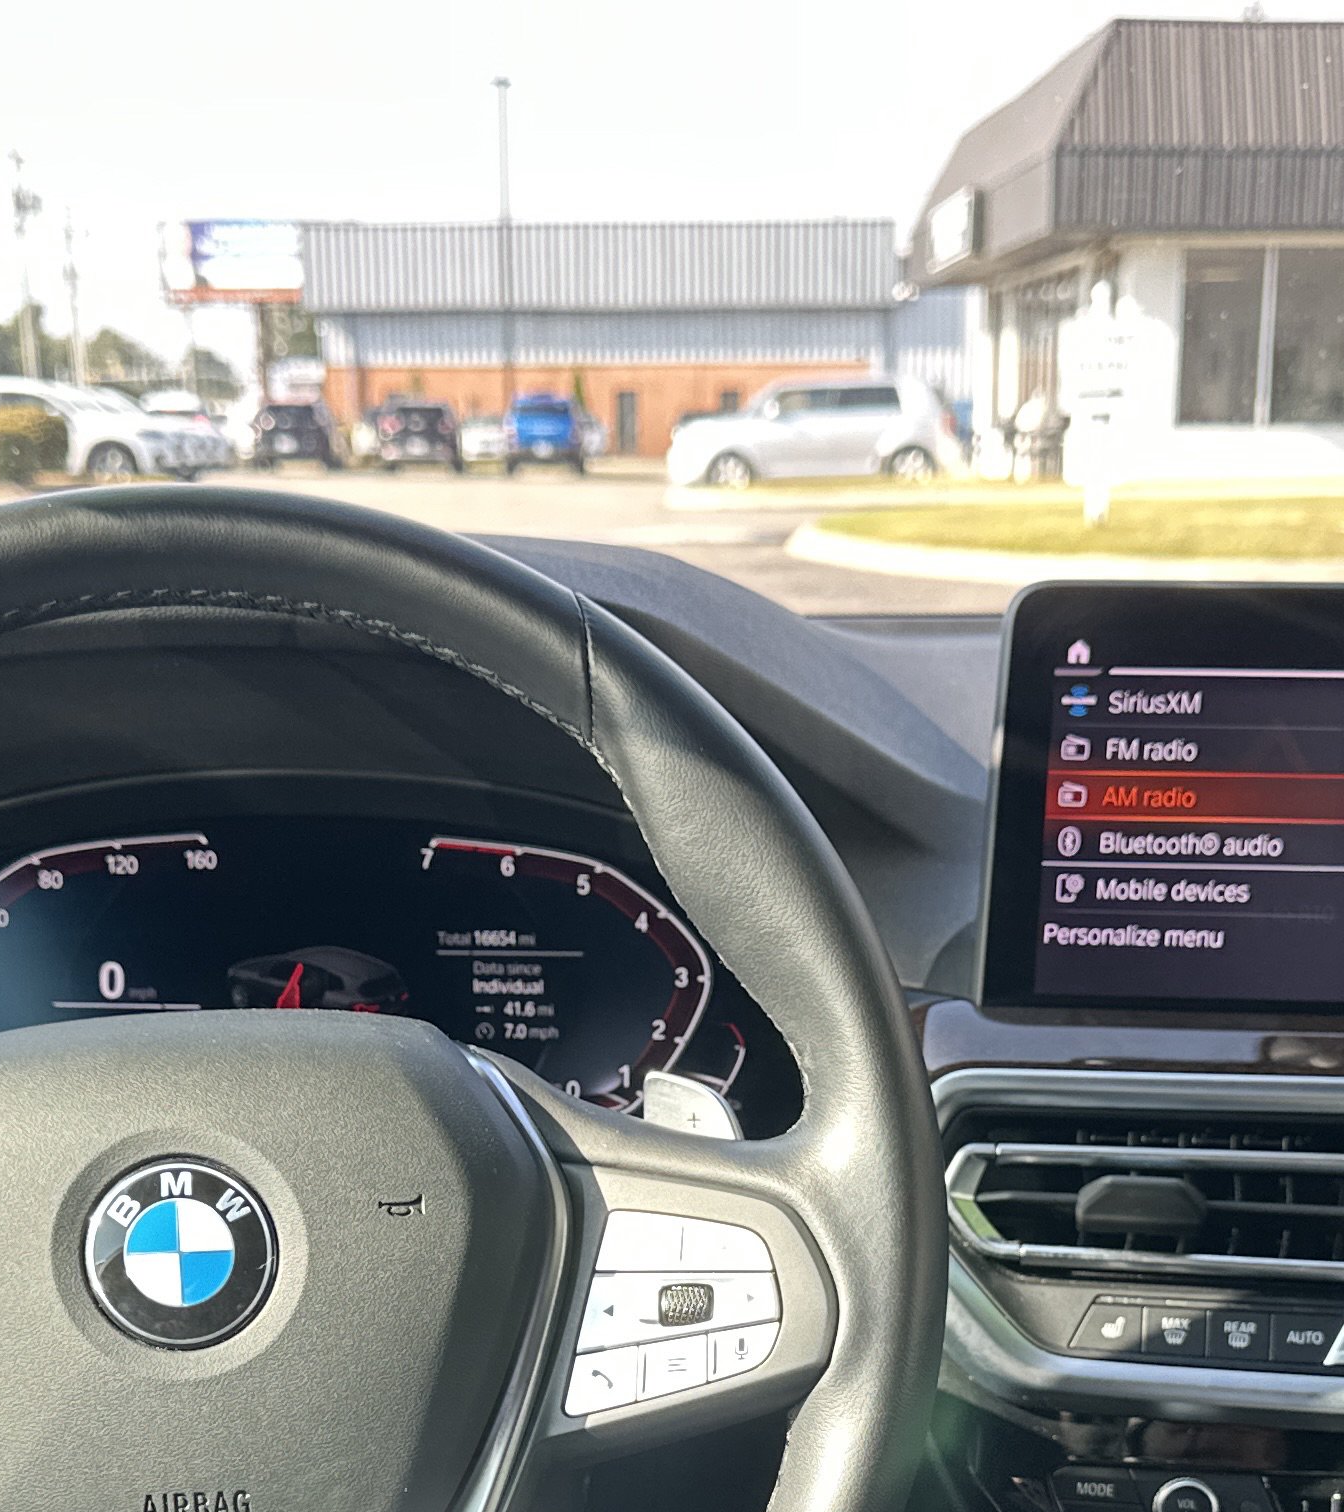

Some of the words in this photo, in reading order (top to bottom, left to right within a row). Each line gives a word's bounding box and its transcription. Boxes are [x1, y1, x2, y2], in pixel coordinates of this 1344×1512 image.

[1108, 690, 1203, 715] SiriusXM
[1105, 737, 1140, 761] FM
[1142, 738, 1199, 762] radio
[1102, 786, 1138, 808] AM
[1142, 786, 1197, 808] radio
[1222, 834, 1285, 857] audio
[106, 854, 140, 876] 120
[183, 849, 218, 870] 160
[420, 847, 435, 870] 7
[500, 855, 516, 877] 6
[37, 869, 65, 890] 80
[576, 874, 592, 896] 5
[1096, 878, 1168, 902] Mobile
[1170, 879, 1252, 904] devices
[634, 911, 650, 933] 4
[1042, 922, 1162, 948] Personalize
[1163, 929, 1225, 949] menu
[472, 960, 505, 977] Data
[506, 960, 543, 977] since
[674, 966, 690, 988] 3
[98, 960, 125, 1000] 0
[472, 978, 545, 996] Individual
[502, 1001, 537, 1018] 41.6
[503, 1023, 528, 1040] 7.0
[651, 1019, 668, 1042] 2
[617, 1064, 632, 1089] 1
[565, 1079, 582, 1100] 0
[107, 1171, 252, 1228] BMW
[1161, 1317, 1190, 1331] MAX
[1223, 1320, 1256, 1335] REAR
[1286, 1329, 1325, 1347] AUTO
[1075, 1481, 1116, 1498] MODE
[1176, 1499, 1197, 1512] VOL
